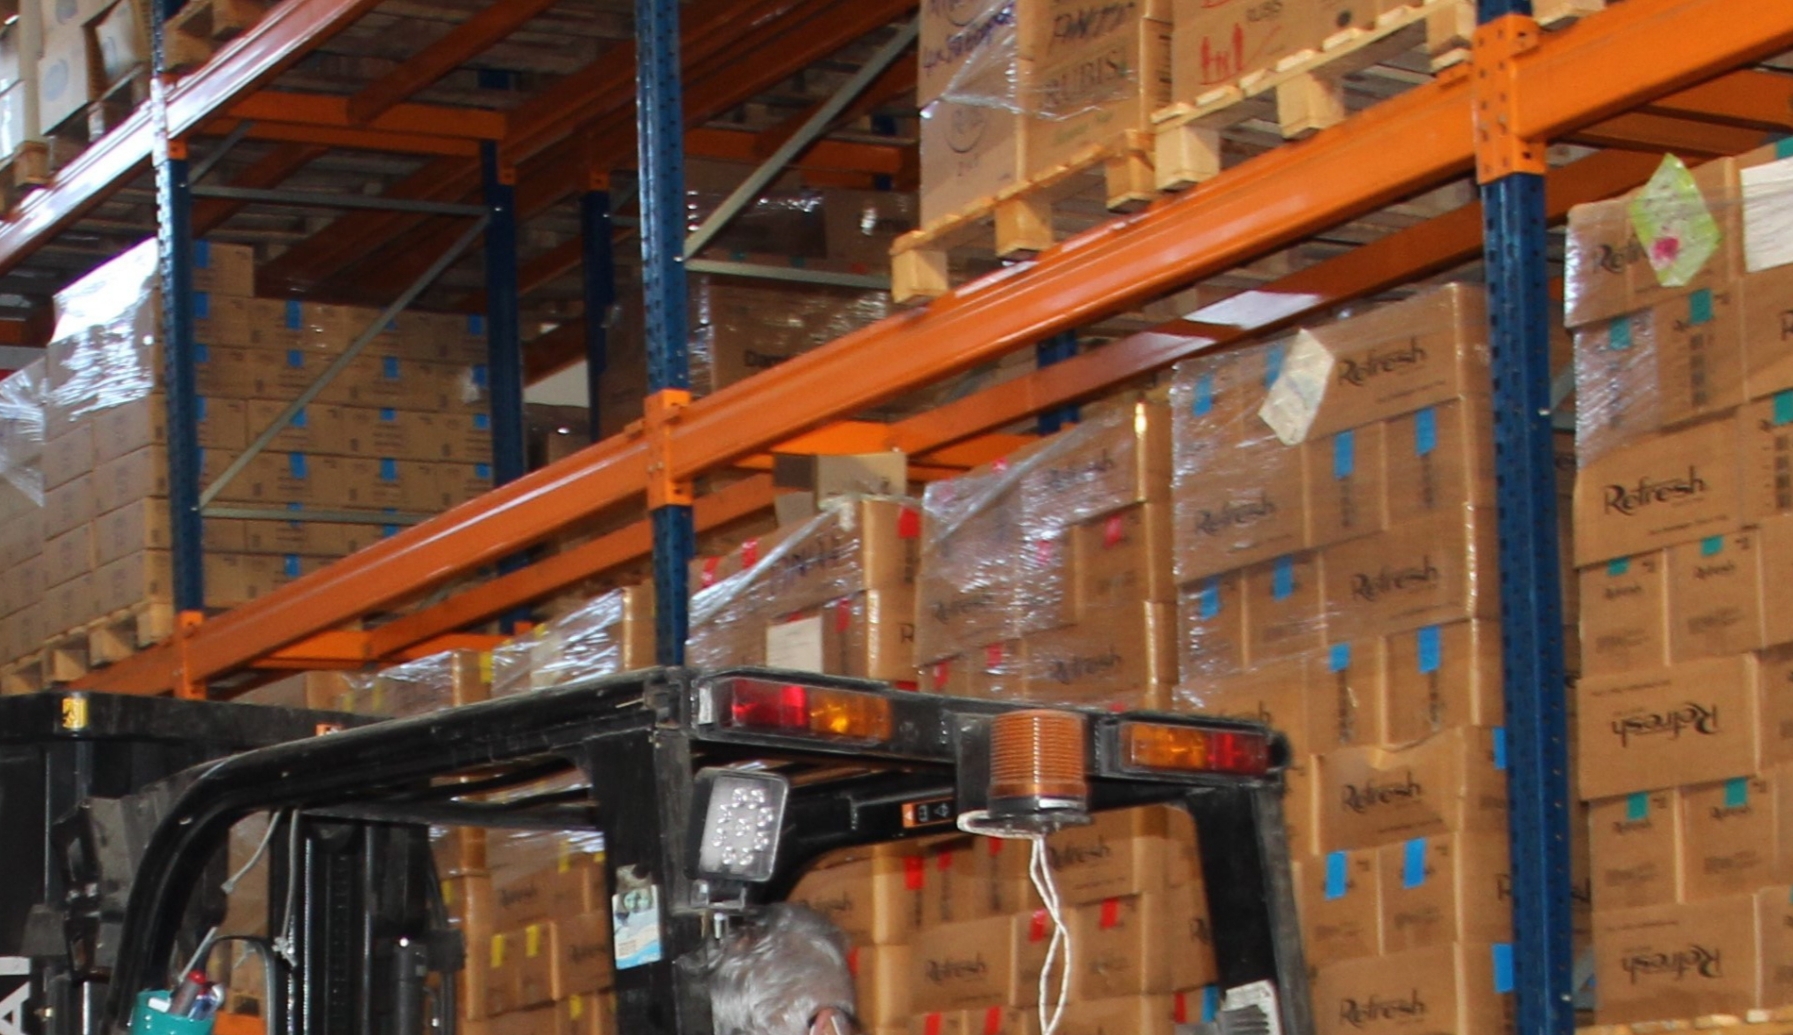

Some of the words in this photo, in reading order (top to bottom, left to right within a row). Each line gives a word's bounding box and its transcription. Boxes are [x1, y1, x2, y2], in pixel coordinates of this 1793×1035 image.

[1337, 336, 1425, 387] Refresh
[1603, 465, 1706, 516] Refresh
[1352, 553, 1438, 602] Refresh
[1610, 702, 1718, 748] Refresh
[1341, 771, 1422, 814] Refresh
[1621, 944, 1721, 985] Refresh
[1337, 989, 1425, 1028] Refresh
